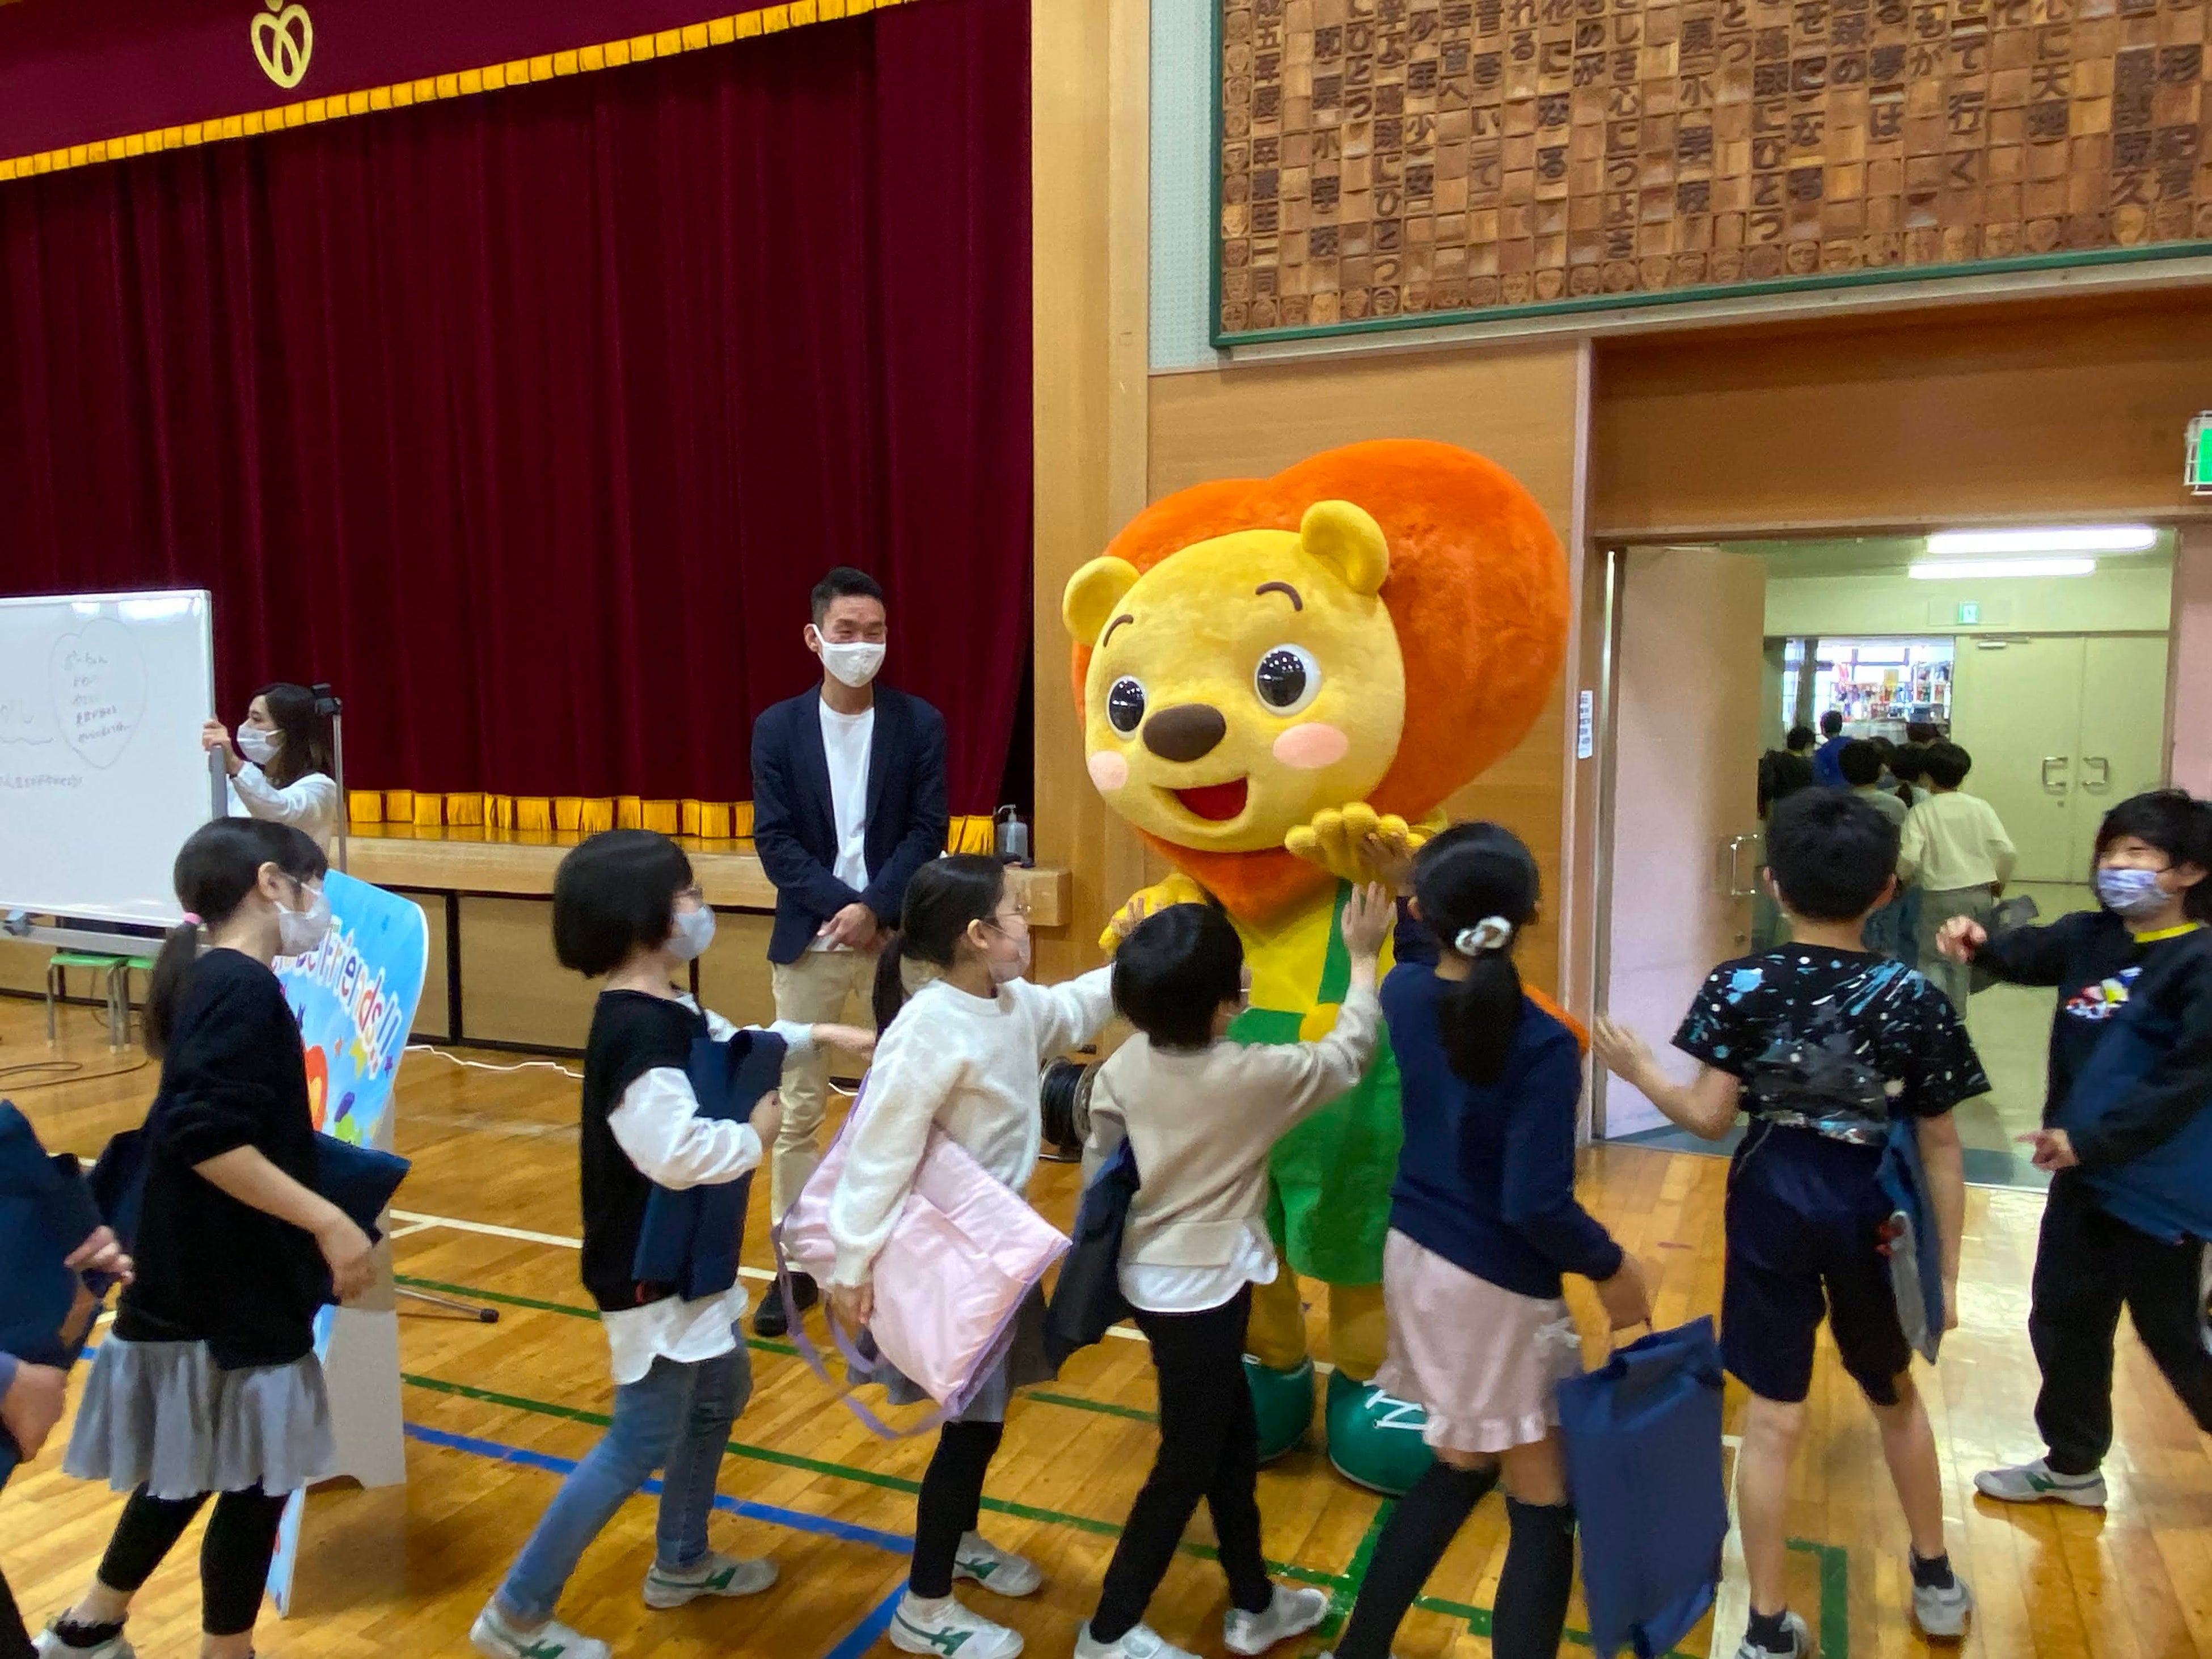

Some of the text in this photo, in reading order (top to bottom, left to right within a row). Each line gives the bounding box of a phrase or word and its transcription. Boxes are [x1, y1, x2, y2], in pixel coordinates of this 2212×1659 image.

[1607, 0, 1640, 259] しき心につよき
